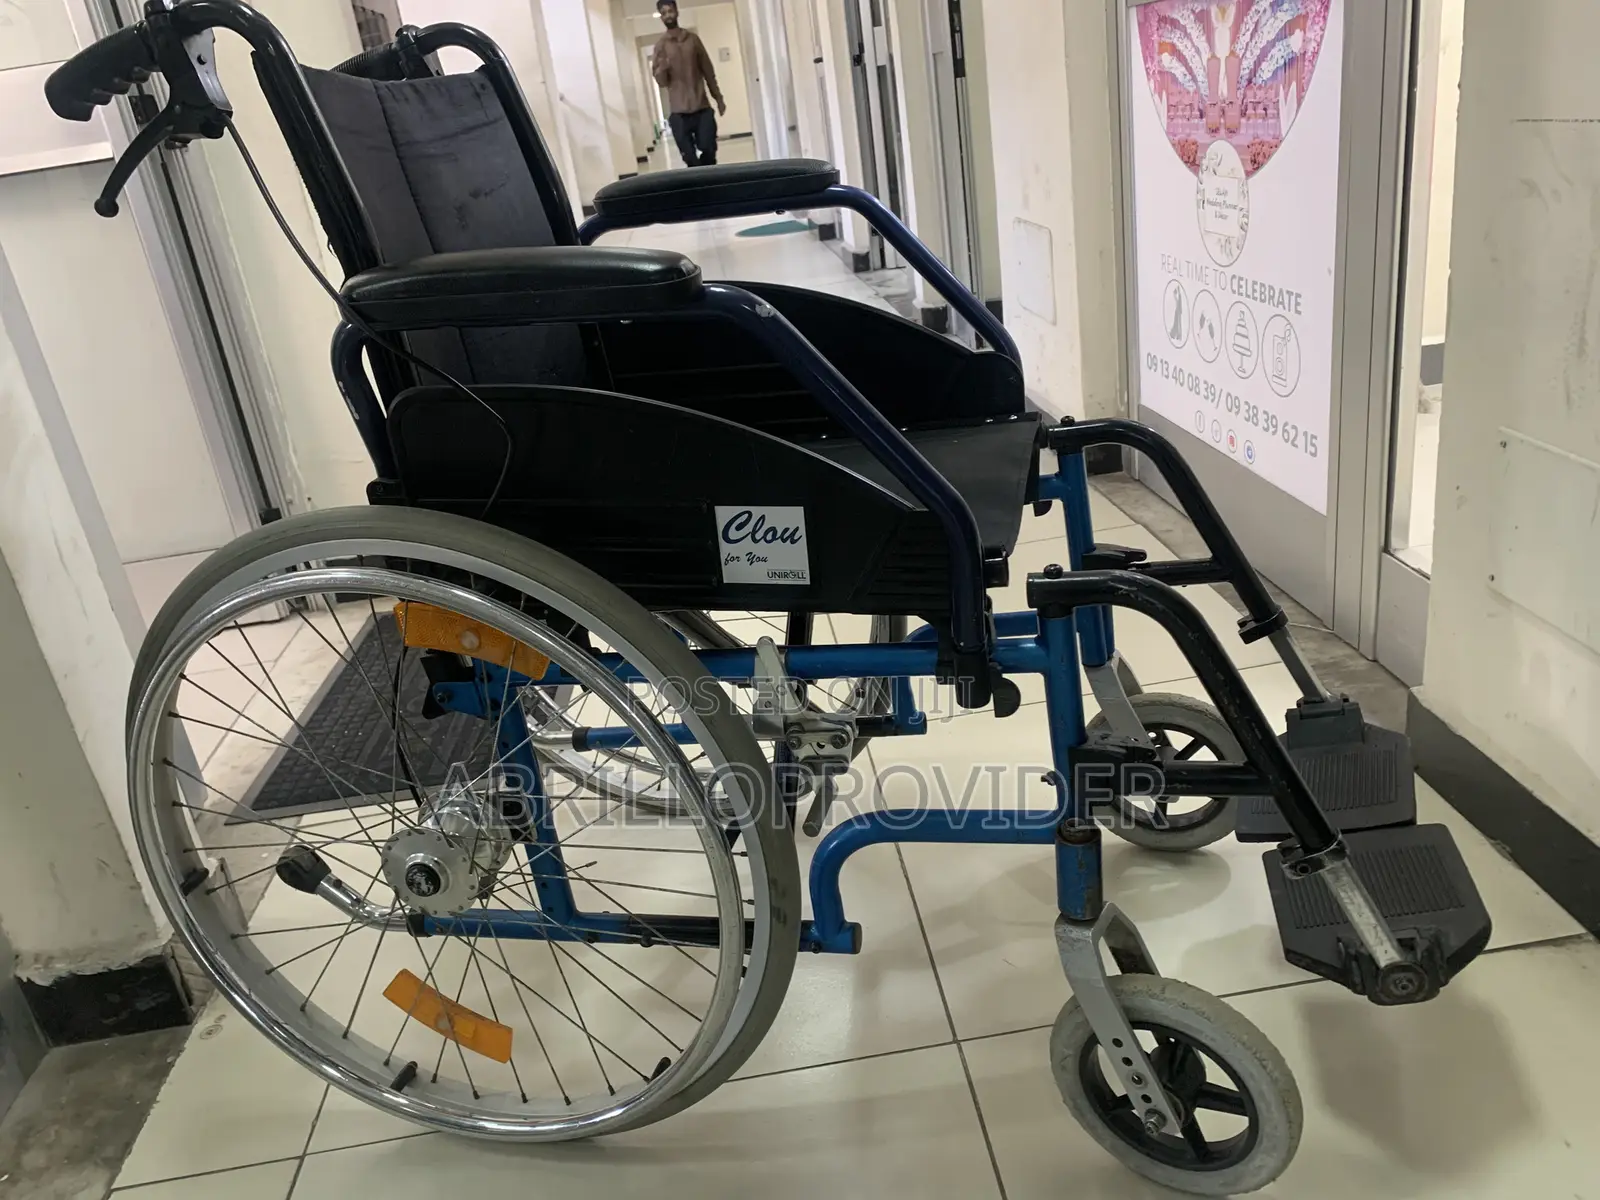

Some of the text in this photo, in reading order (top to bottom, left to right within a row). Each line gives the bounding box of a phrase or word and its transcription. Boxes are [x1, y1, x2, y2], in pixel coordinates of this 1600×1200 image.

[1161, 253, 1303, 316] REAL TIME TO CELEBRATE
[1146, 352, 1158, 373] 09
[1160, 358, 1170, 380] 13
[1171, 365, 1185, 388] 40
[1187, 372, 1200, 396] 08
[1225, 391, 1241, 416] 09
[1243, 400, 1259, 427] 38
[1262, 409, 1278, 436] 39
[1281, 420, 1299, 449] 62
[1302, 430, 1318, 458] 15
[721, 510, 803, 545] Clou
[724, 551, 769, 566] for You
[767, 569, 807, 580] UNIROLL
